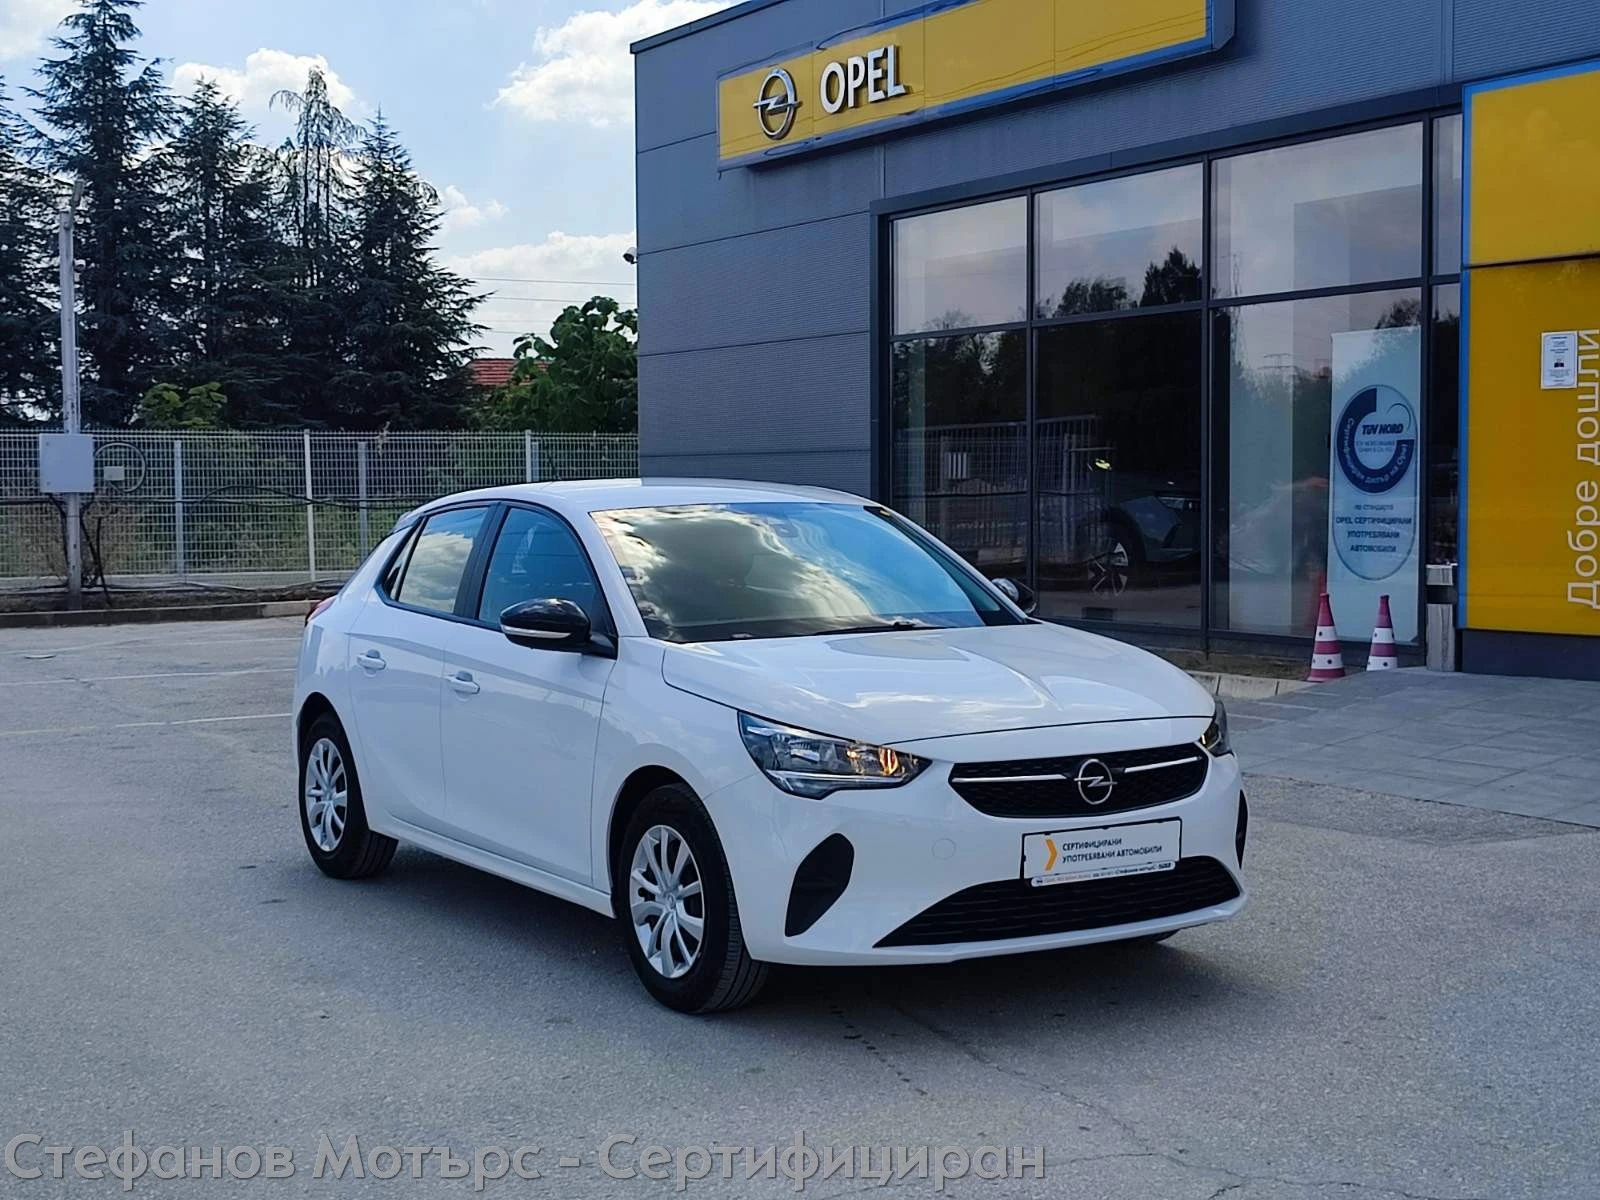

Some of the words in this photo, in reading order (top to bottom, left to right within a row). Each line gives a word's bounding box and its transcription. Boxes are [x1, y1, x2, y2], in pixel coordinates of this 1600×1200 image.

[820, 44, 906, 114] OPEL
[1576, 329, 1600, 466] дошли
[1379, 423, 1404, 435] NORD
[1336, 516, 1353, 524] OPEL
[1354, 516, 1412, 525] СЕРТИФИЦИРАНИ
[1347, 530, 1400, 539] УПОТРЕБЯВАНИ
[1350, 544, 1397, 553] АВТОМОБИЛИ
[1567, 479, 1600, 610] Добре
[1062, 838, 1122, 852] СЕРТИФИЦИРАНИ
[1062, 850, 1115, 864] УПОТРЕБЯВАНИ
[1116, 845, 1162, 858] АВТОМОБИЛИ
